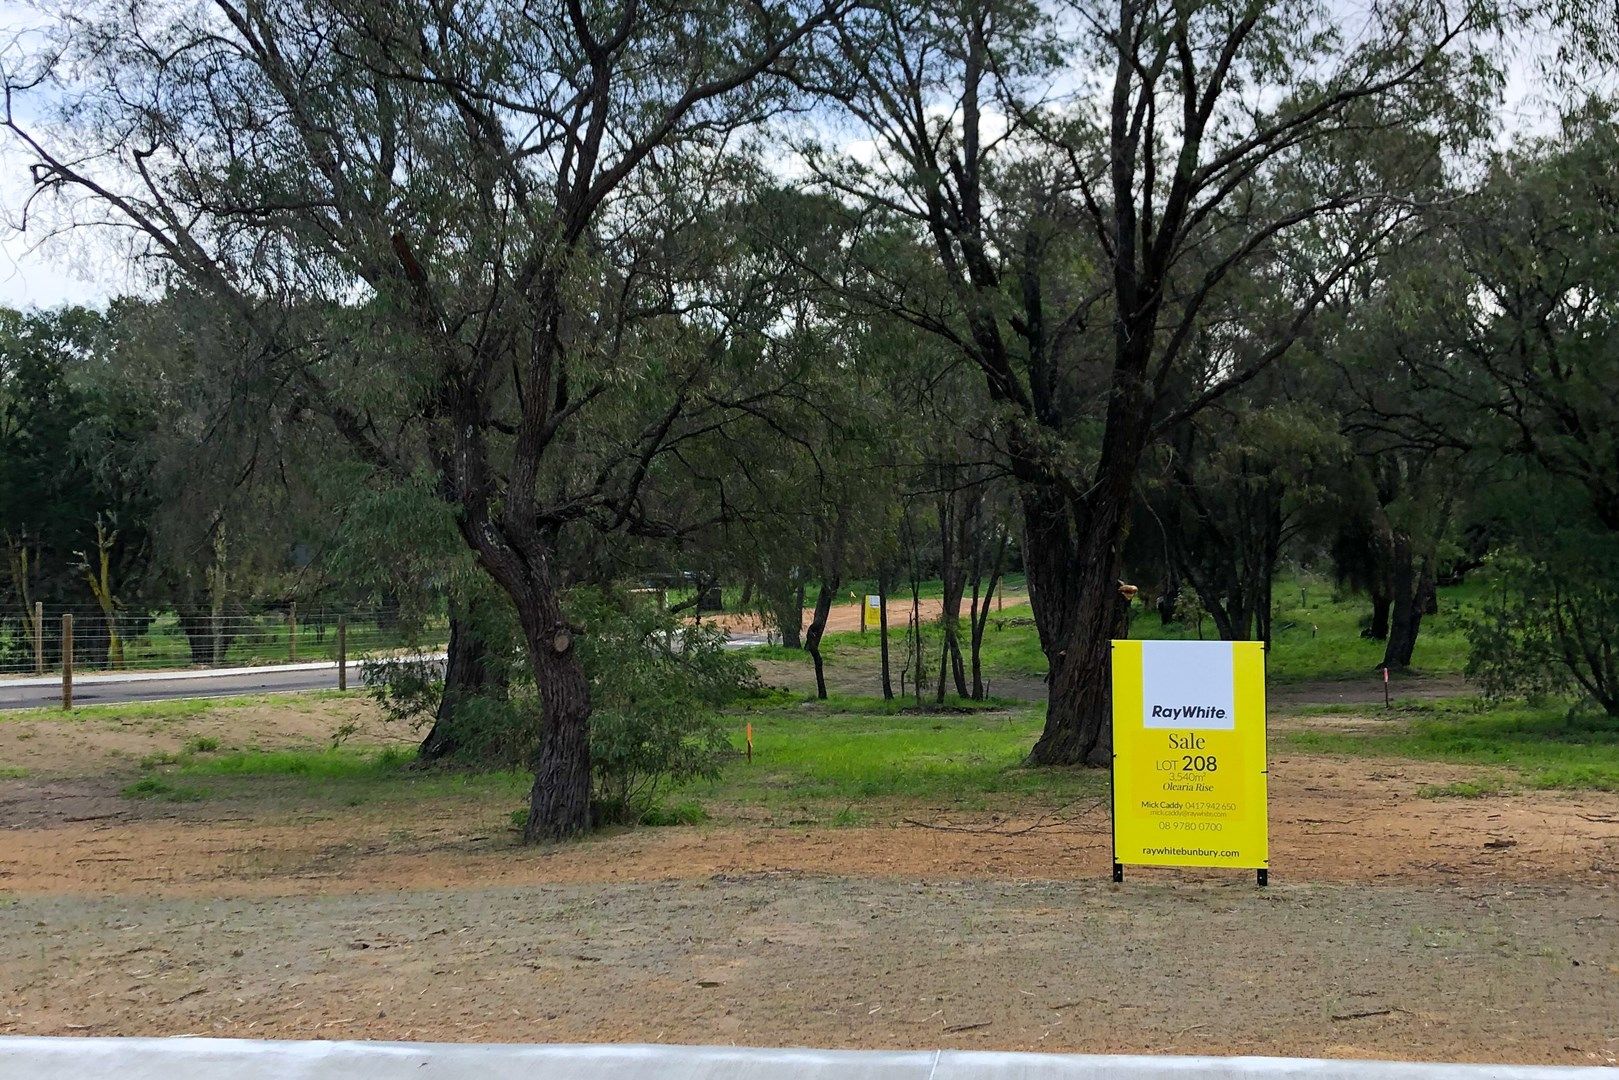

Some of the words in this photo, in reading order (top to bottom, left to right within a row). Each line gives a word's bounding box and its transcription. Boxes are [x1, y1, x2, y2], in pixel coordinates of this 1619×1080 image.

[1168, 733, 1206, 750] Sale
[1156, 760, 1179, 771] LOT
[1182, 755, 1218, 772] 208
[1162, 782, 1194, 791] Olearia
[1195, 783, 1214, 792] Rise
[1141, 801, 1159, 809] Mick
[1160, 801, 1184, 810] Caddy
[1158, 821, 1171, 830] 08
[1173, 821, 1197, 831] 9780
[1198, 822, 1223, 832] 0700
[1142, 846, 1240, 858] raywhitebunbury.com
